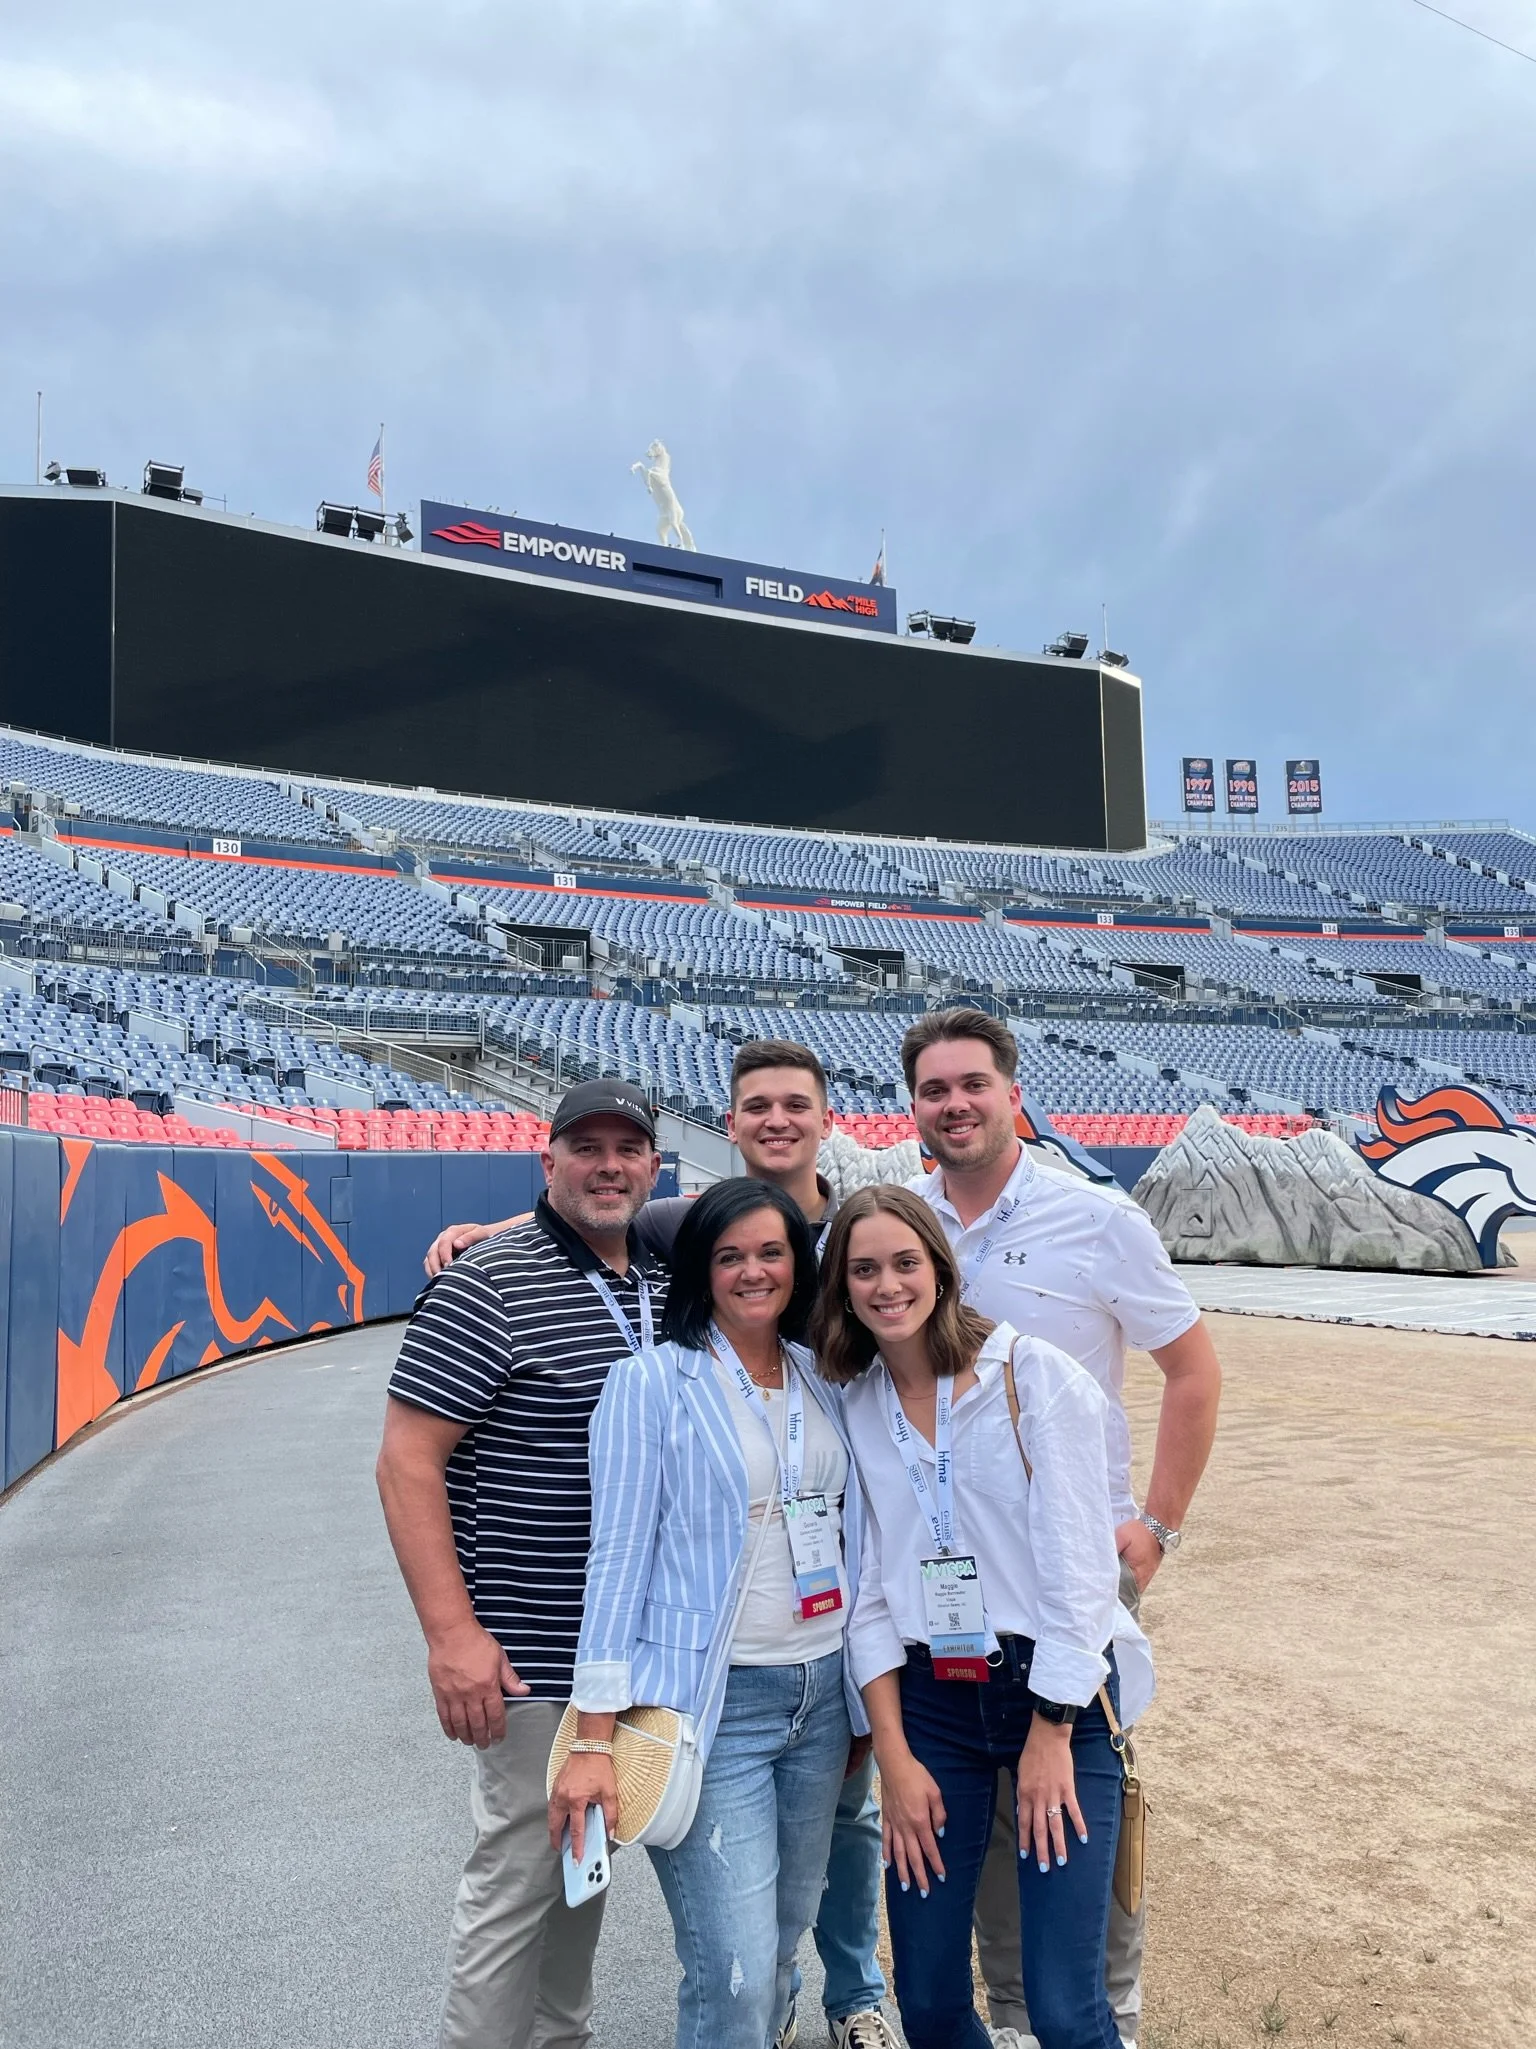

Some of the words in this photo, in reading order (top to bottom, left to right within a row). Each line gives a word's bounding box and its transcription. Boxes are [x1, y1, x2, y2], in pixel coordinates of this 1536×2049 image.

[503, 531, 626, 572] EMPOWER
[745, 576, 805, 603] FIELD
[855, 596, 877, 608] MILE
[855, 605, 878, 617] HIGH
[1186, 778, 1212, 791] 1997
[1229, 780, 1256, 793] 1998
[1289, 780, 1319, 793] 2015
[216, 841, 239, 854] 130
[557, 876, 574, 887] 131
[830, 899, 865, 908] EMPOWER
[868, 902, 888, 910] FIELD
[1099, 915, 1112, 924] 133
[1323, 924, 1337, 933] 134
[1504, 928, 1519, 937] 135
[624, 1324, 640, 1352] hfma
[736, 1368, 755, 1398] hfma
[790, 1412, 802, 1441] hfma
[896, 1412, 909, 1443] hfma
[938, 1450, 951, 1484] hfma
[935, 1560, 976, 1577] VISPA
[812, 1598, 835, 1613] SPONSOR
[946, 1667, 977, 1679] SPONSOR
